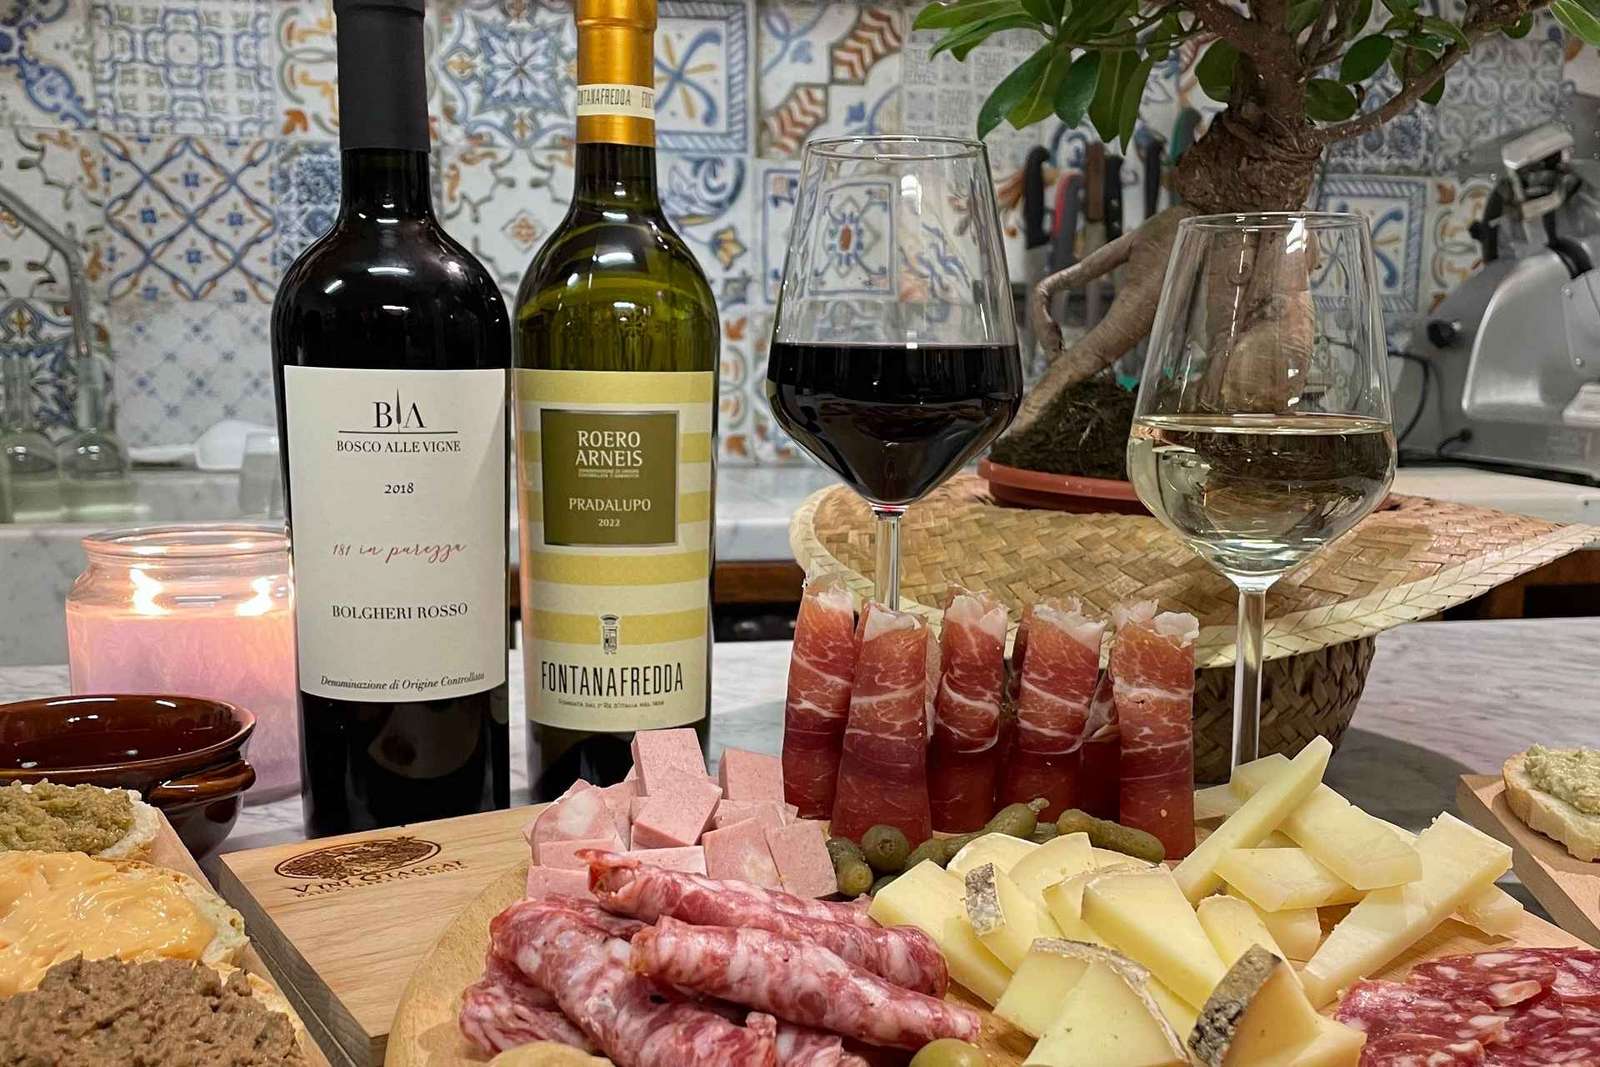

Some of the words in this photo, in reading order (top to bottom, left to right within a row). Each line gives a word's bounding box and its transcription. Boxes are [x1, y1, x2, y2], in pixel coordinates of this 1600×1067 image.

[337, 440, 381, 453] BOSCO
[384, 441, 420, 453] ALLE
[422, 440, 461, 453] VIGNE
[577, 430, 641, 448] ROERO
[575, 449, 643, 467] ARNEIS
[383, 482, 415, 494] 2018
[568, 497, 651, 512] PRADALUPO
[597, 518, 620, 527] 2022
[332, 605, 412, 619] BOLGHERI
[417, 602, 468, 618] ROSSO
[320, 675, 387, 690] Denominazione
[388, 680, 400, 690] di
[401, 679, 439, 692] Origine
[440, 671, 485, 687] Controllata
[541, 660, 683, 697] FONTANAFREDDA
